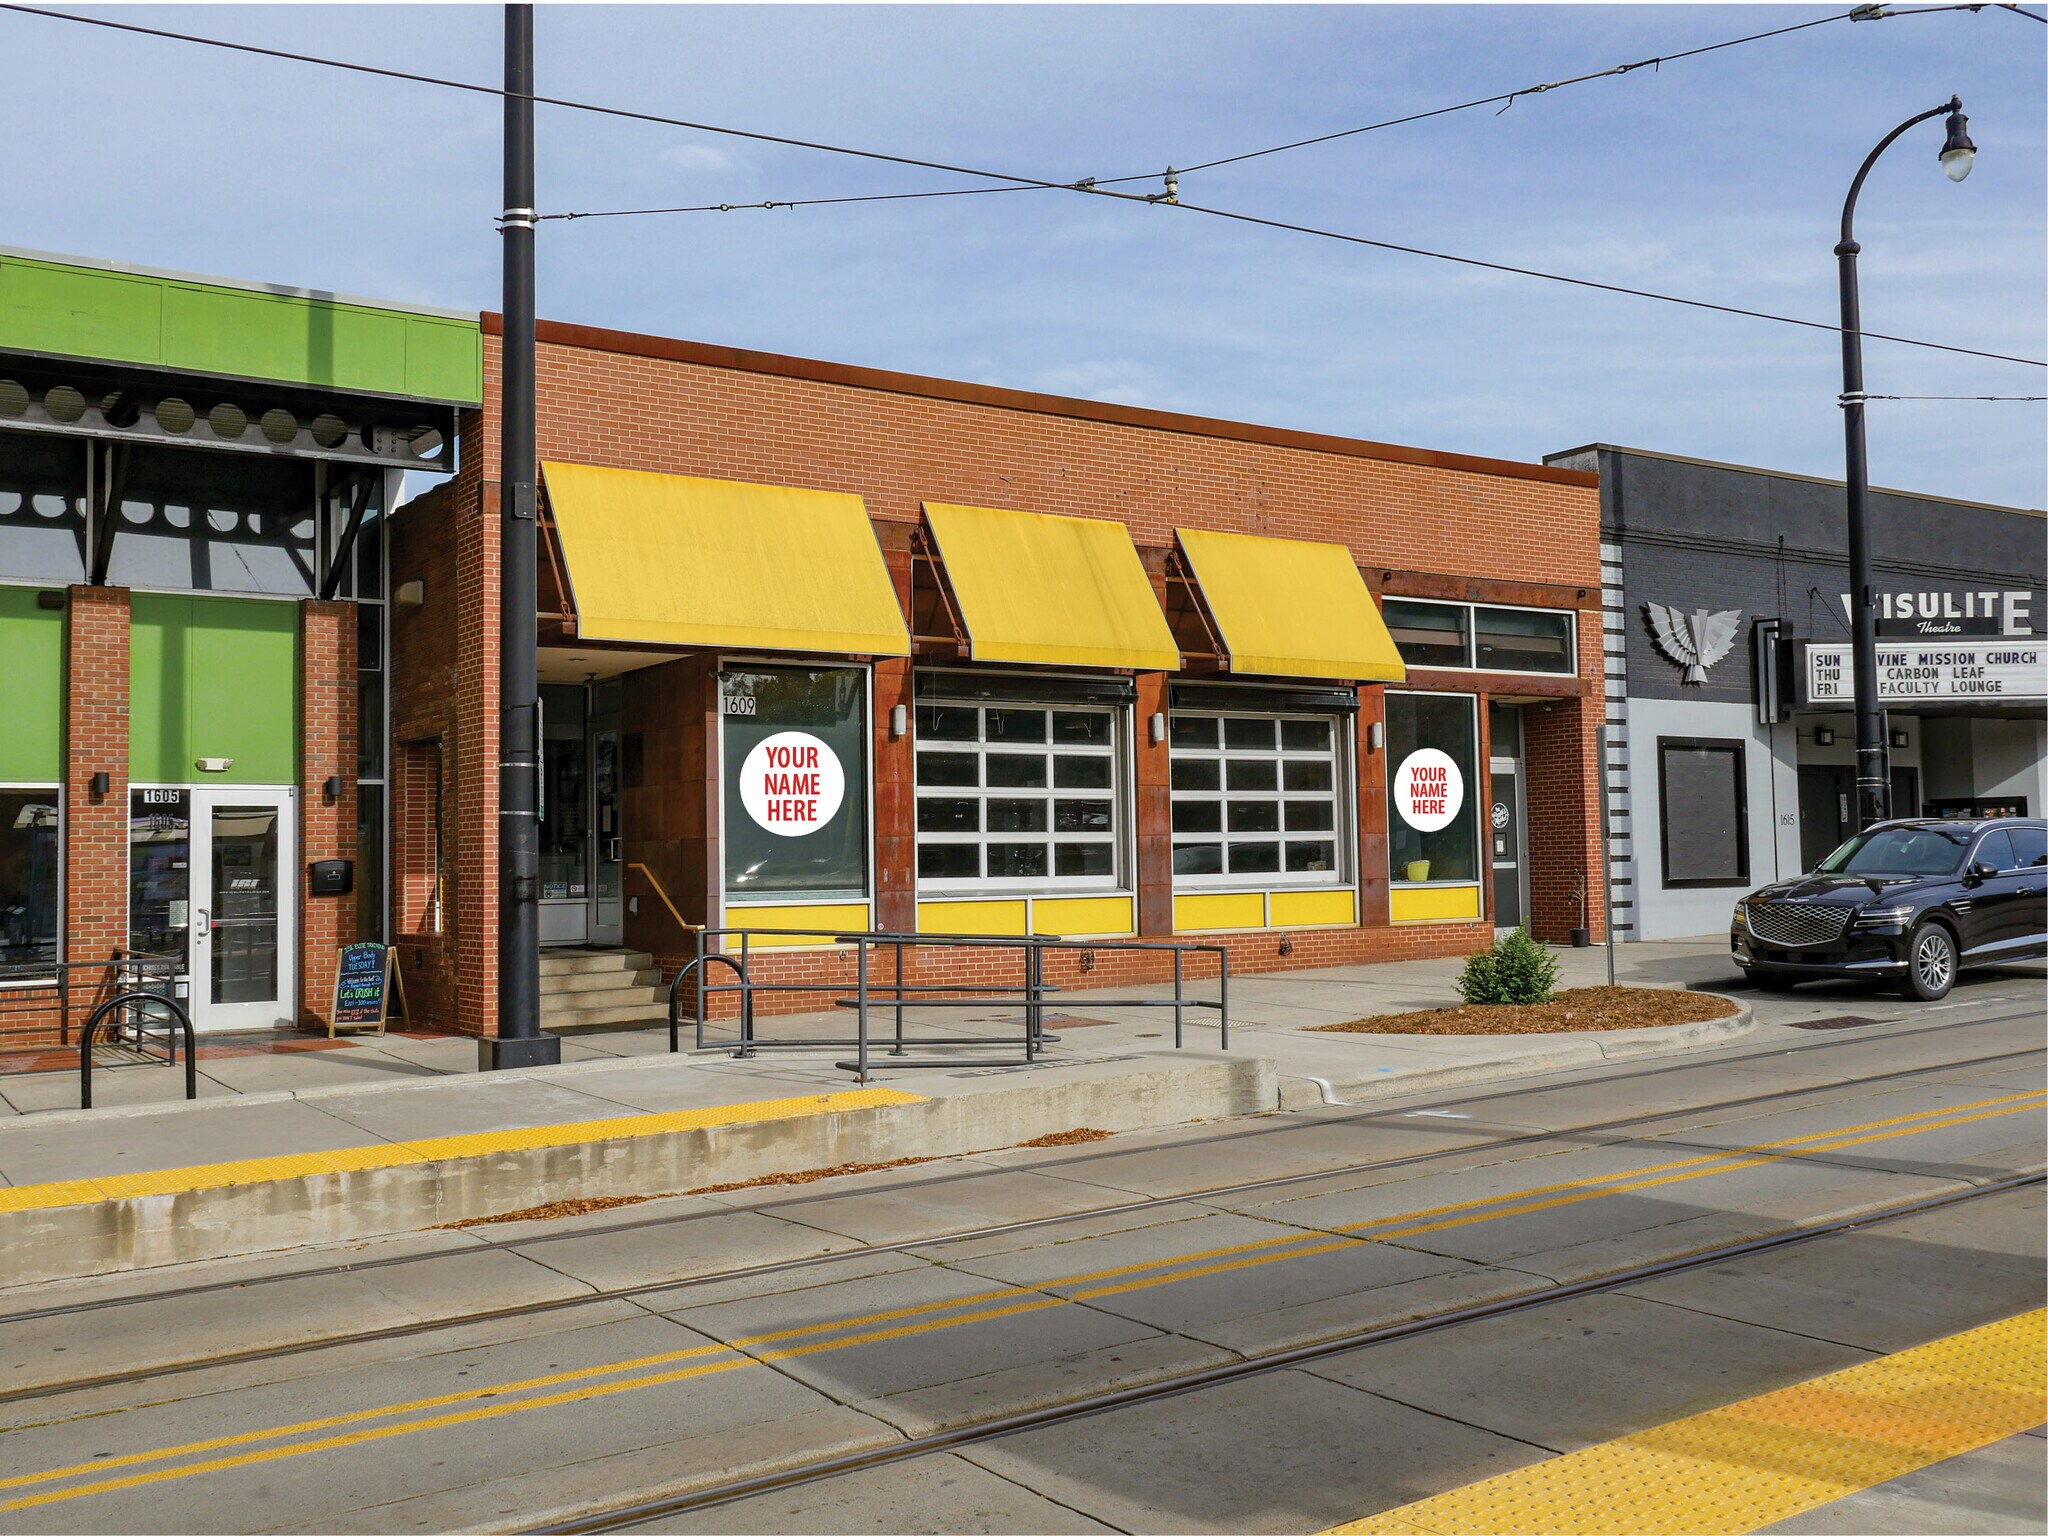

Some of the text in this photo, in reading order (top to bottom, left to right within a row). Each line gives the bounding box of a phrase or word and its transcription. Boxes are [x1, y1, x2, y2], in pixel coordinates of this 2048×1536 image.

[1916, 621, 1961, 634] Theatre
[1816, 654, 1840, 667] SUN
[1918, 652, 1975, 666] MISSION
[1986, 651, 2037, 664] CHURCH
[1816, 667, 1985, 681] THU CARBON LEAF
[1817, 680, 2002, 695] FRI FACULTY LOUNGE
[723, 697, 755, 713] 1609
[146, 789, 178, 802] 1605
[1780, 814, 1795, 825] 1615
[363, 951, 375, 960] Body
[340, 987, 379, 998] Let's CRUSH it
